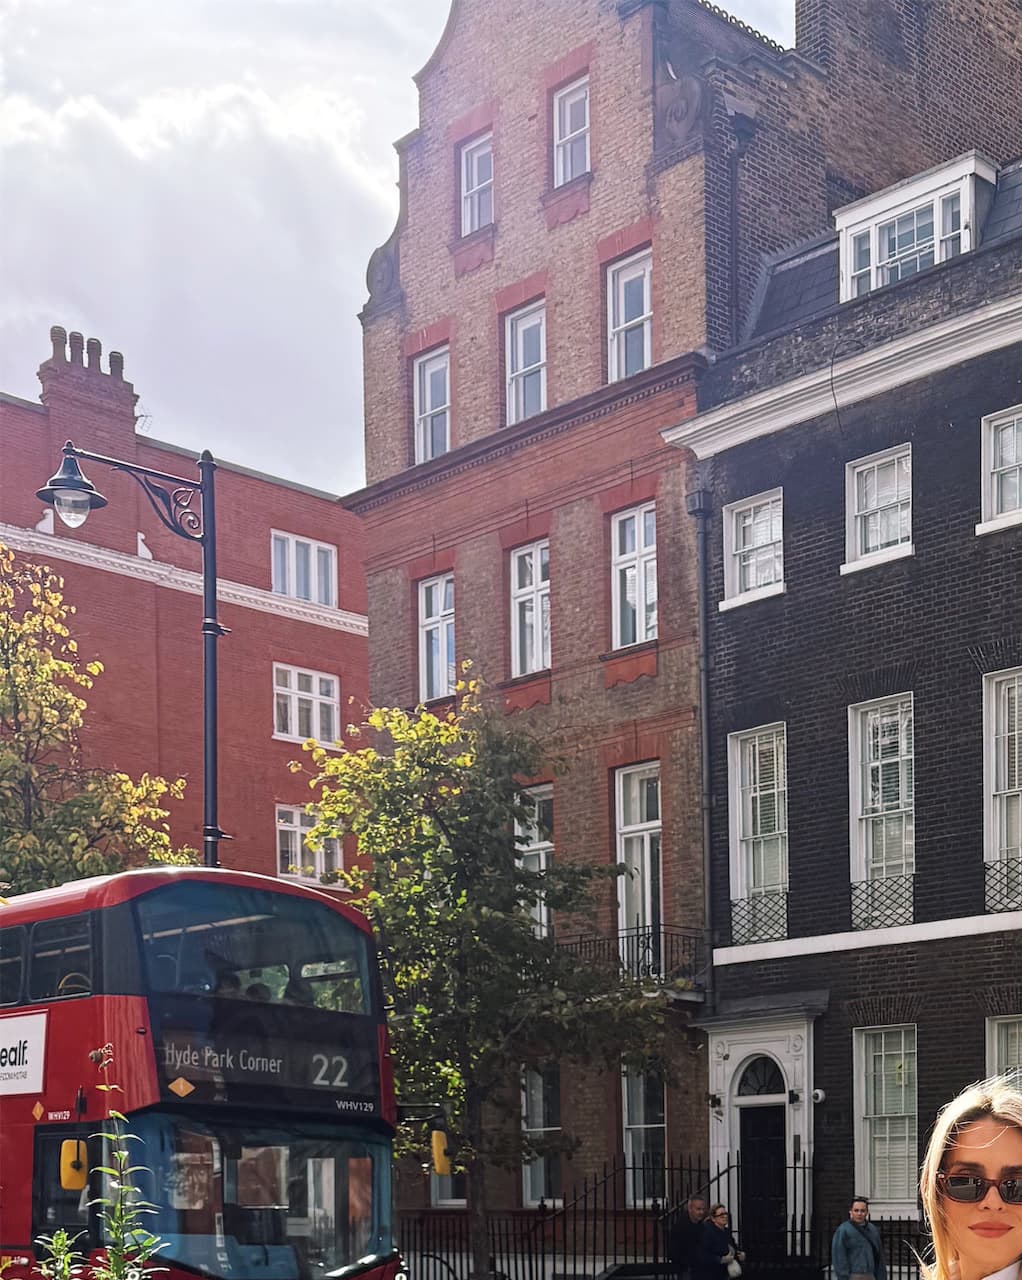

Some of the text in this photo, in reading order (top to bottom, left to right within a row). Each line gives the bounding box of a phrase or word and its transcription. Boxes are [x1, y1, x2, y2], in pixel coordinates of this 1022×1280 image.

[0, 1040, 28, 1067] ealf.
[165, 1043, 283, 1073] Hyde Park Corner
[312, 1053, 349, 1088] 22
[335, 1100, 374, 1112] WHV129
